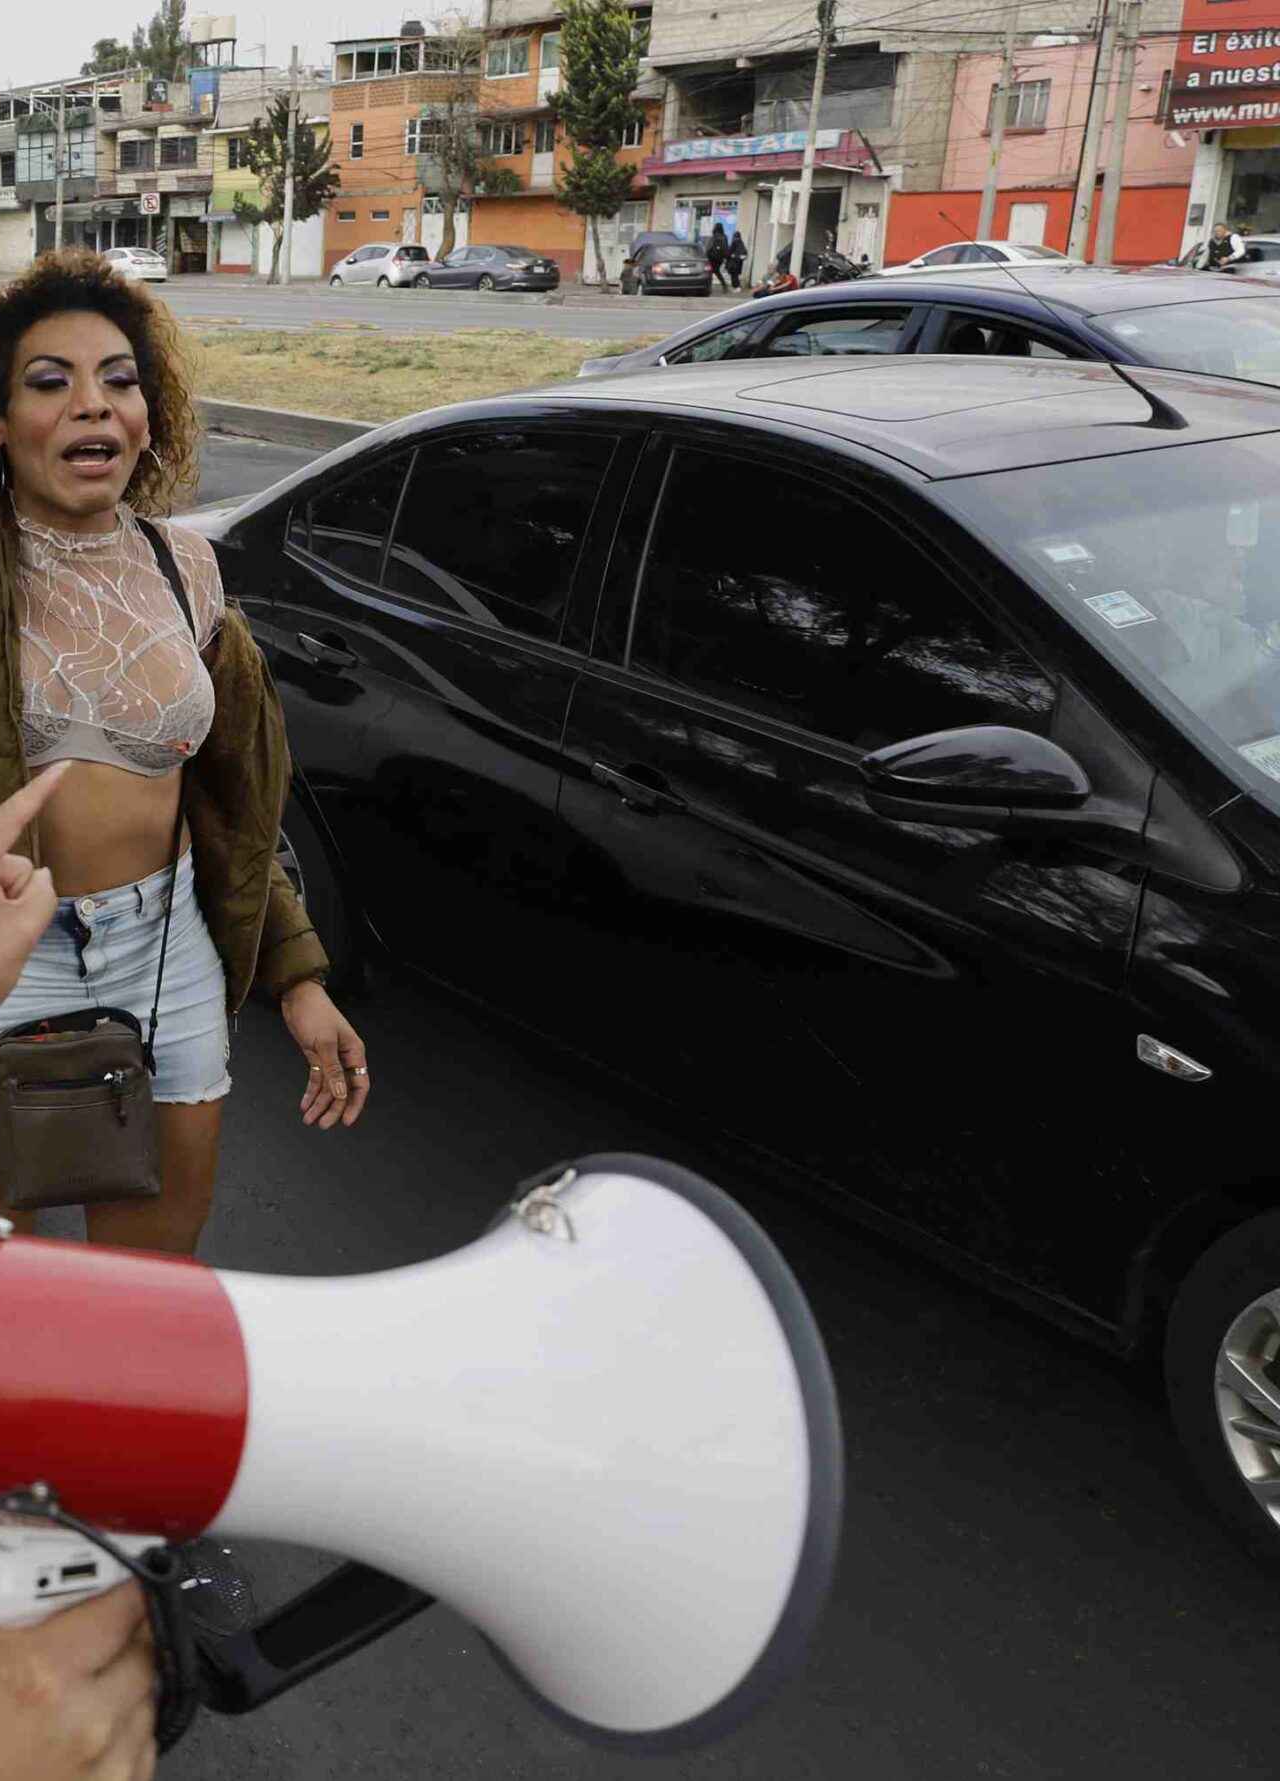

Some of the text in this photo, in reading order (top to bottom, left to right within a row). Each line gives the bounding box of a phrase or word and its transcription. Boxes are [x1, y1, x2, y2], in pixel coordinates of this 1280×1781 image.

[1192, 33, 1217, 54] El
[1186, 63, 1280, 87] a nuest
[1173, 102, 1280, 123] www.mu
